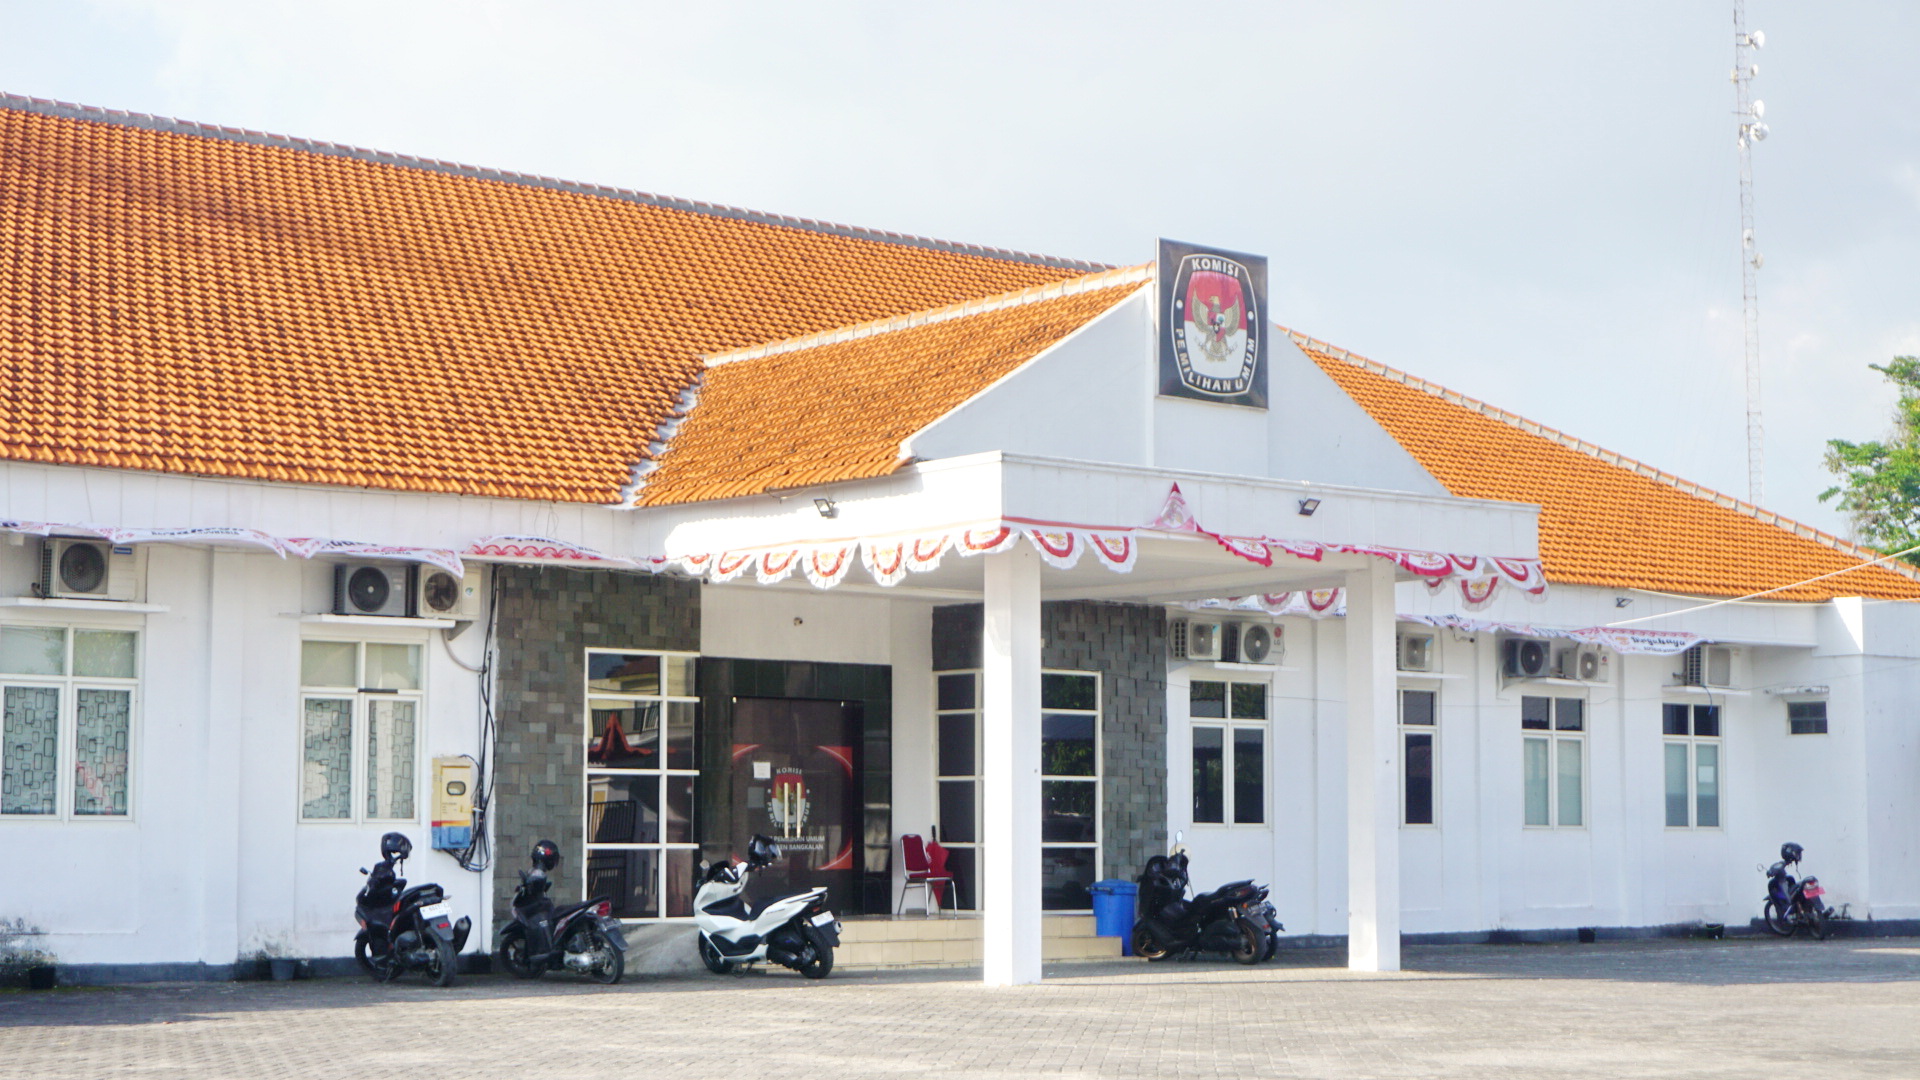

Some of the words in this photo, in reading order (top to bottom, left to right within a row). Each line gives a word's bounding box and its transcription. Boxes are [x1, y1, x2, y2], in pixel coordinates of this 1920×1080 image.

[1192, 258, 1239, 277] KOMISI
[1175, 328, 1231, 391] PEMILIHAN
[1235, 338, 1255, 389] UMUM
